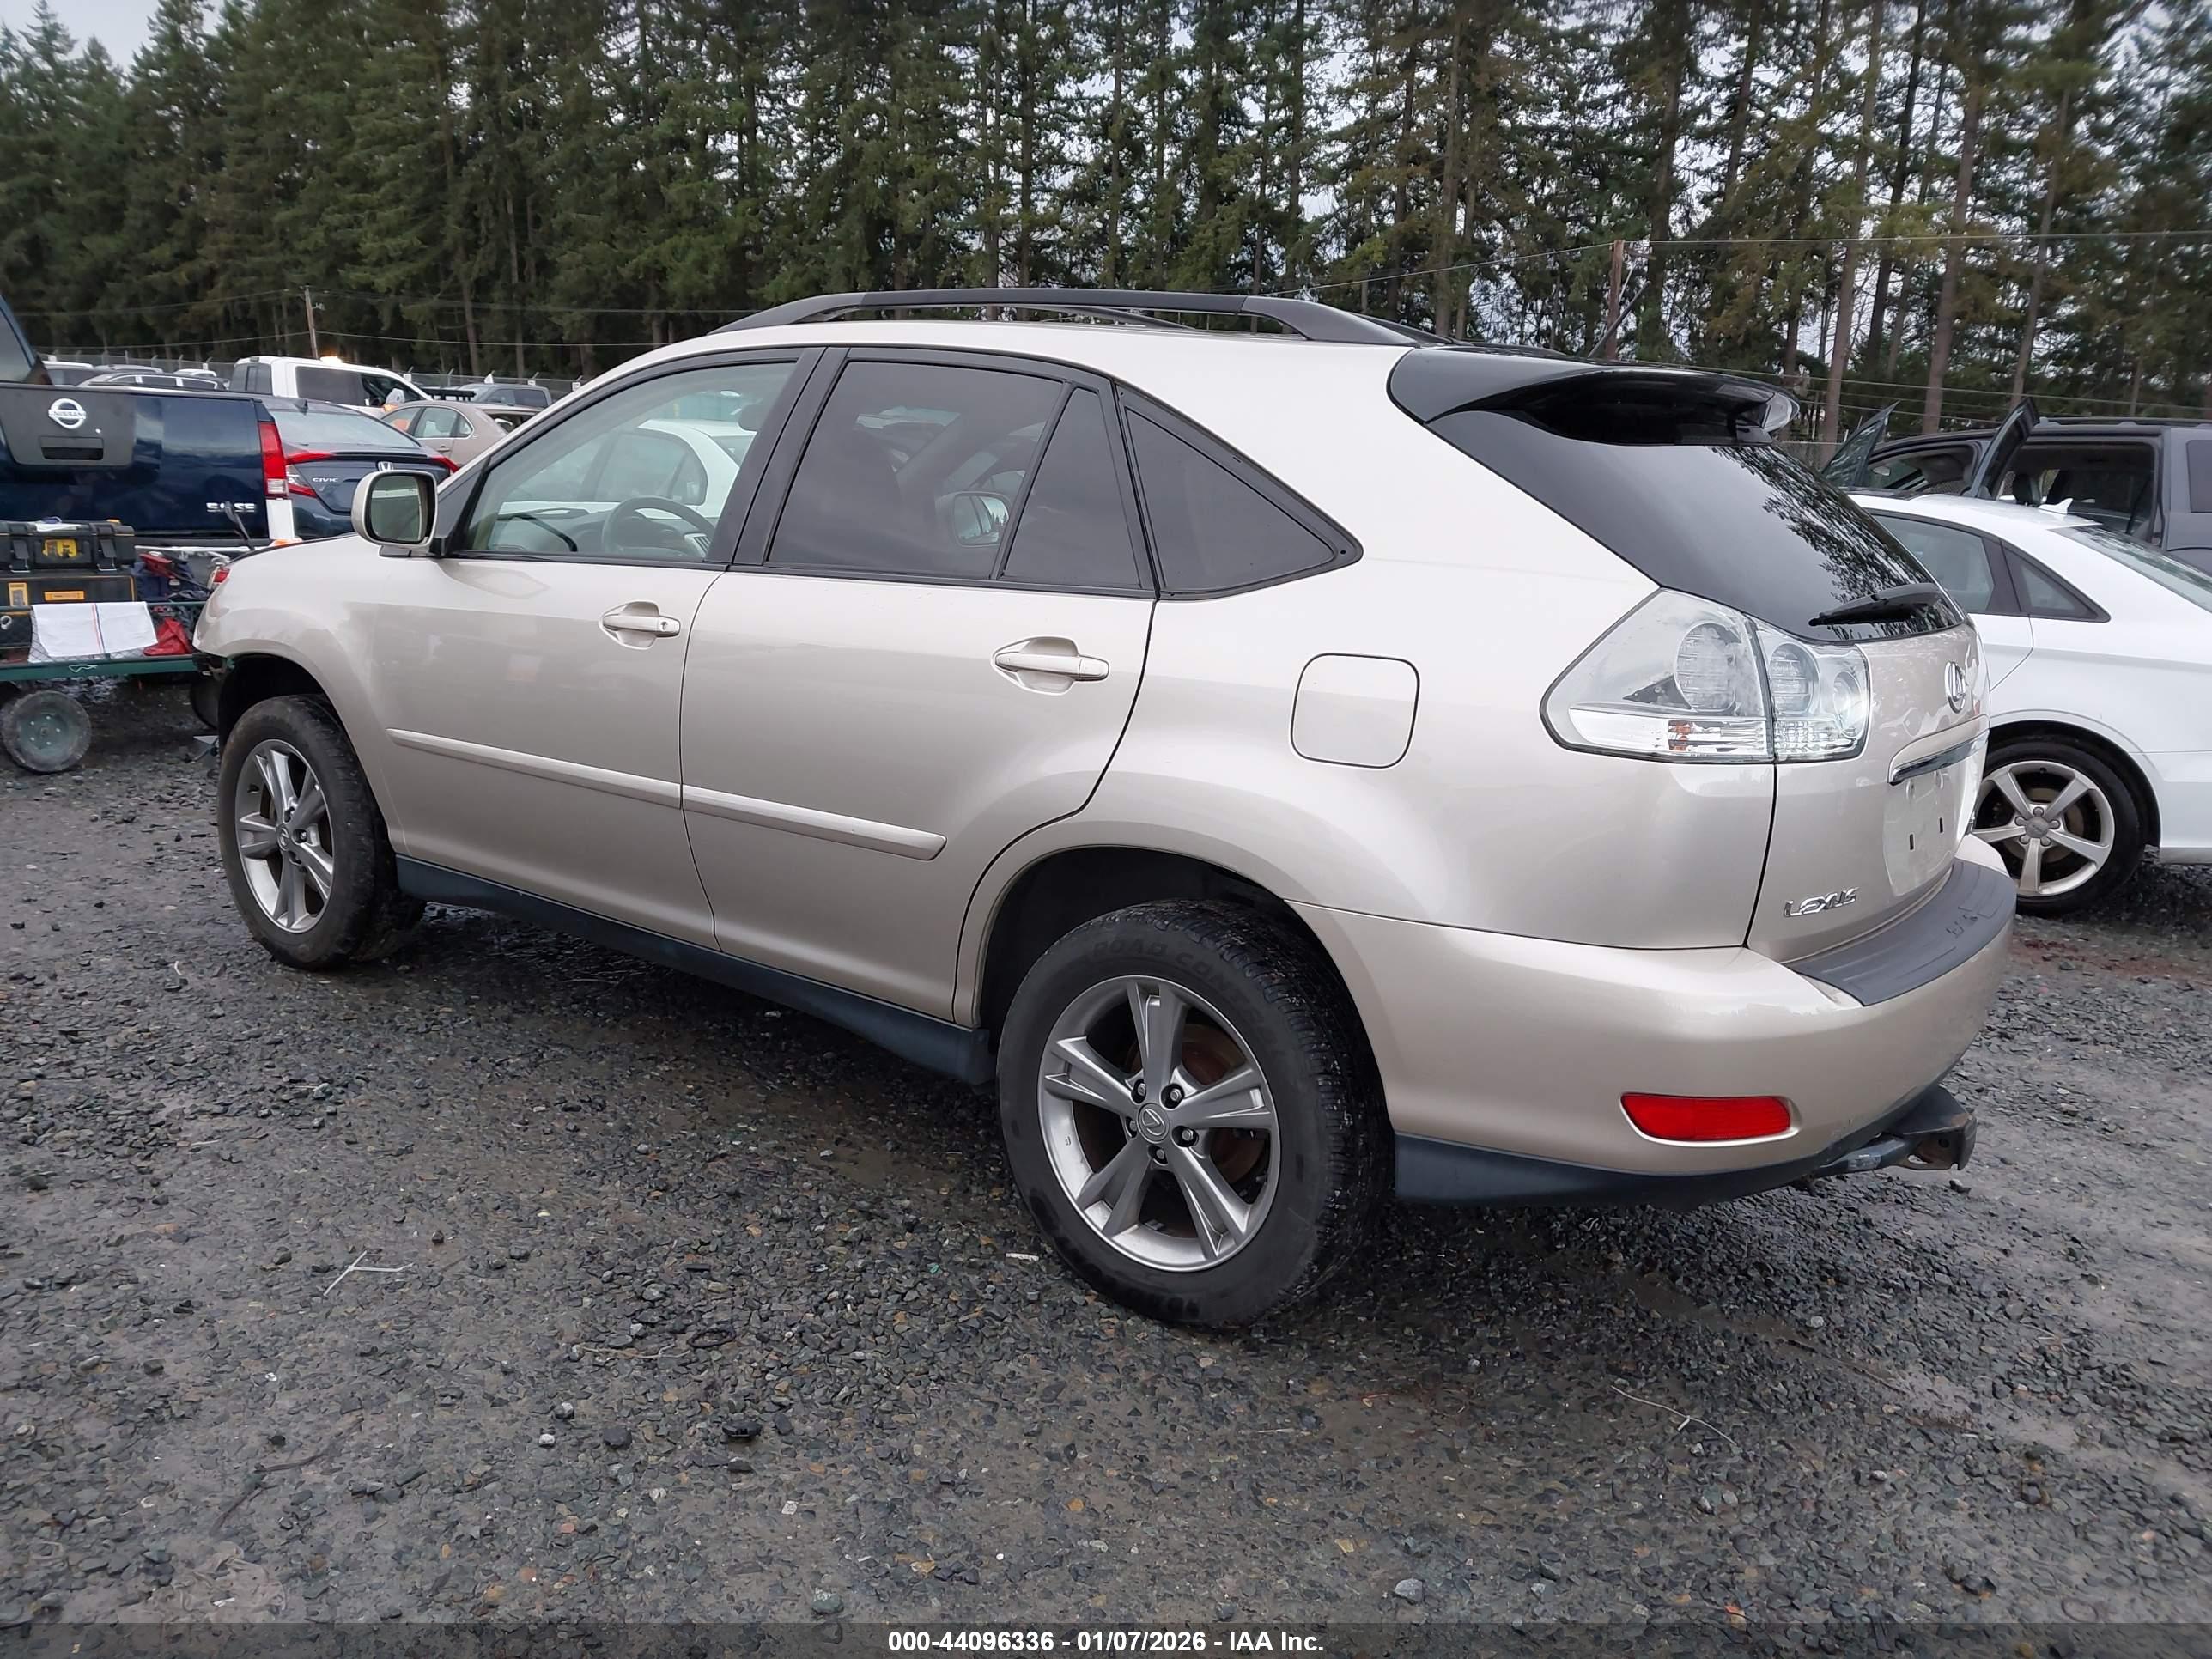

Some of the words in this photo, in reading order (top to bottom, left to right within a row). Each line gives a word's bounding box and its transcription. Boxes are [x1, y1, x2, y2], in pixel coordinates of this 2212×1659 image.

[234, 502, 255, 511] SE
[1784, 887, 1859, 917] LEXUS
[1092, 938, 1170, 958] ROAD
